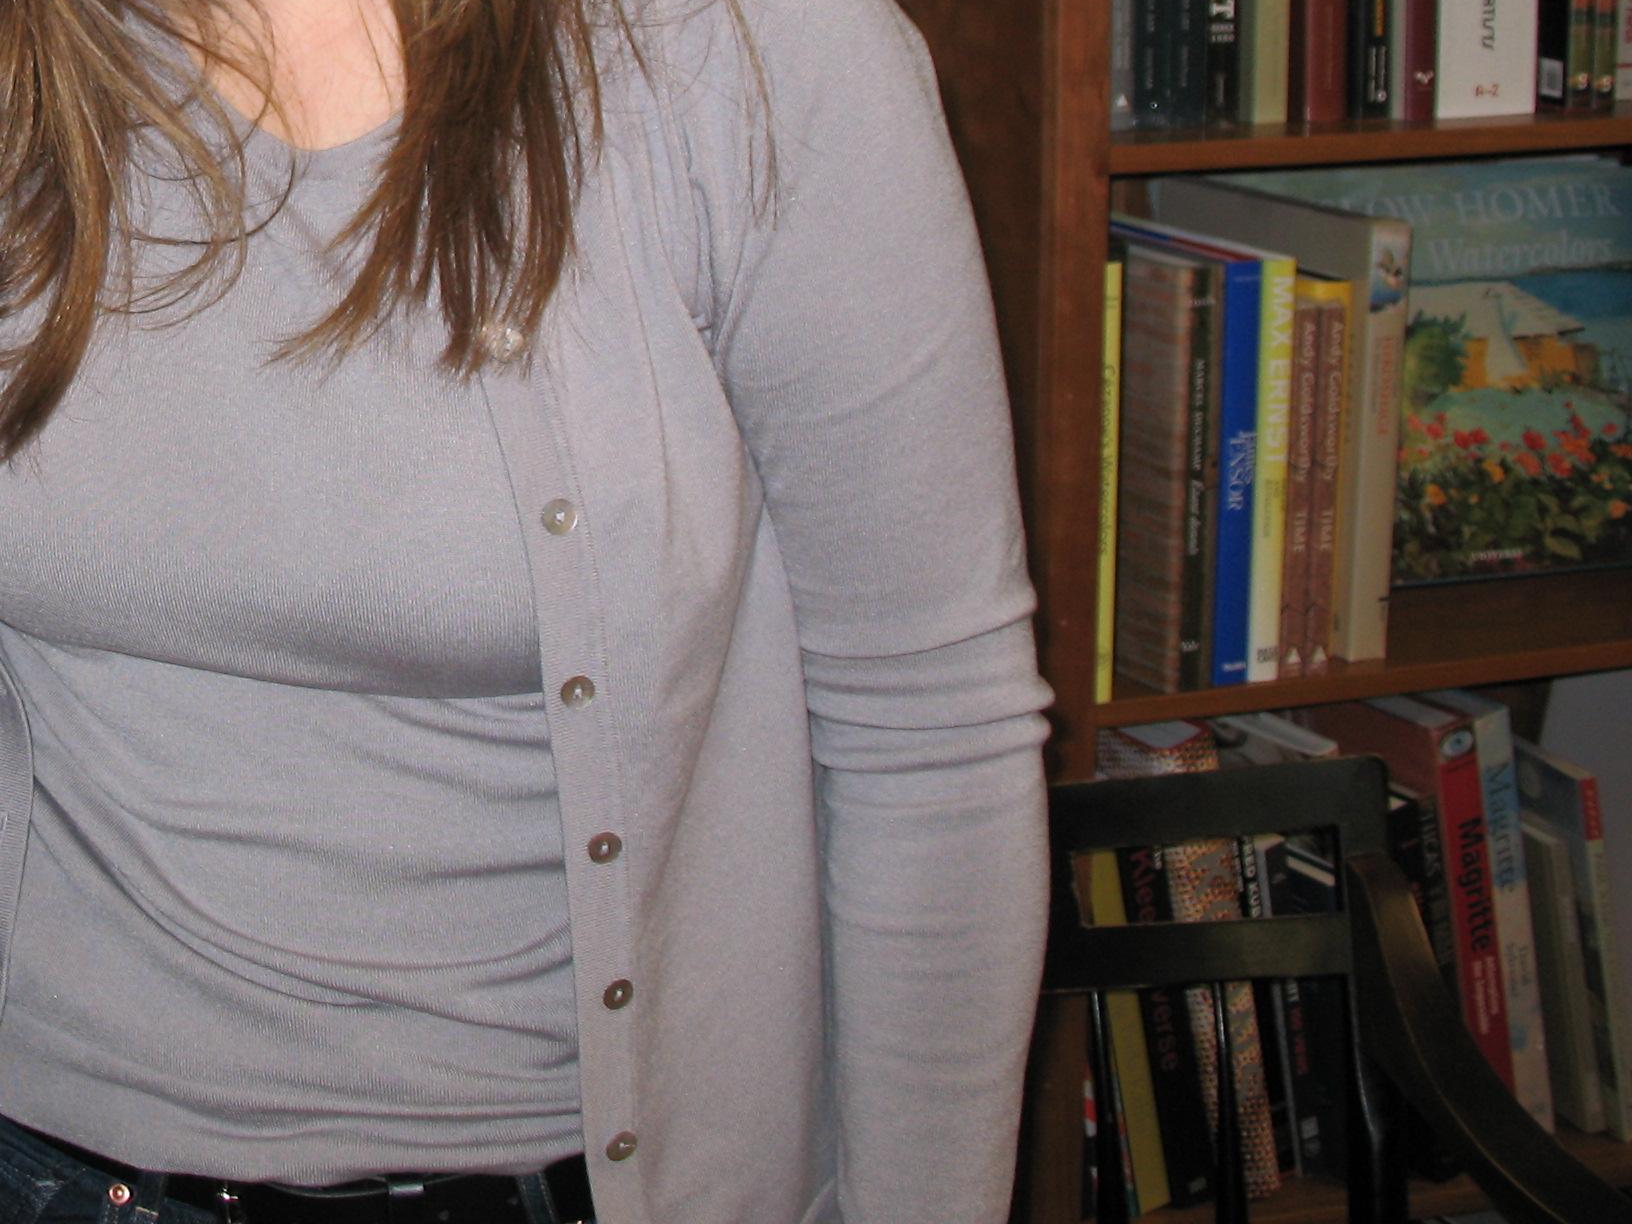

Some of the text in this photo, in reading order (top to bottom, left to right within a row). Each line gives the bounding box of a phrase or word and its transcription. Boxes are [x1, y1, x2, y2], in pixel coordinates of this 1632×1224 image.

[1424, 227, 1617, 273] Watercolors
[1453, 181, 1622, 225] HOMER
[1271, 277, 1293, 348] MAX
[1265, 359, 1289, 462] ERNST
[1292, 322, 1317, 553] Andy Goldsworthy TIME
[1319, 320, 1345, 552] Andy Goldsworthy TIME
[1455, 817, 1493, 953] Magritte
[1483, 761, 1517, 894] Magritte
